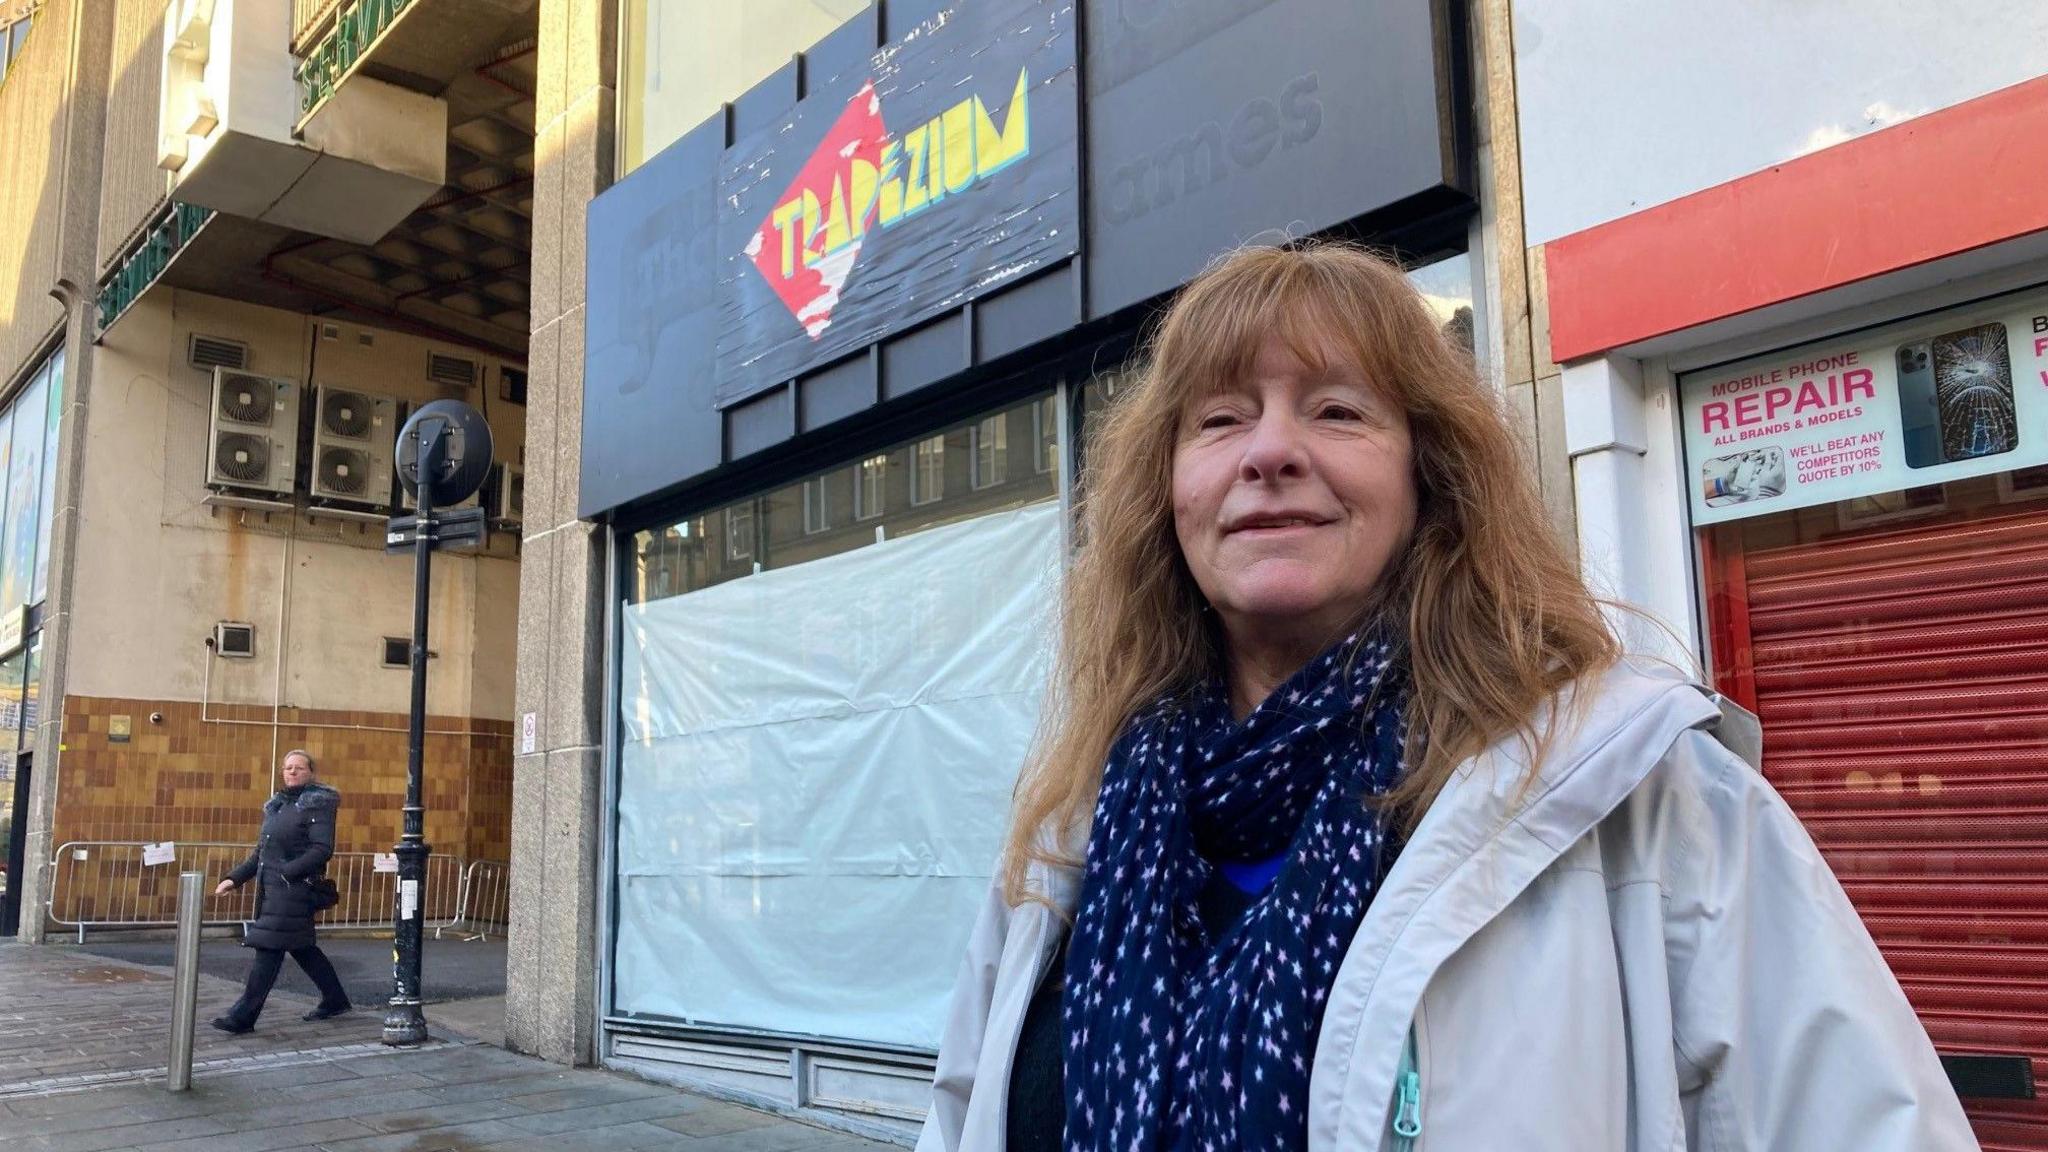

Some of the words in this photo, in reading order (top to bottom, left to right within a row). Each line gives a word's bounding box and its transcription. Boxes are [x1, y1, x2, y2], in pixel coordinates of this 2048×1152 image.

[773, 65, 1029, 279] TRAPEZIUM
[1712, 370, 1783, 397] MOBILE
[1789, 352, 1859, 379] PHONE
[1702, 368, 1875, 434] REPAIR
[1714, 434, 1736, 447] ALL
[1740, 422, 1790, 441] BRANDS
[1795, 419, 1803, 429] &
[1808, 407, 1863, 426] MODELS
[1790, 443, 1825, 458] WE'LL
[1828, 435, 1858, 451] BEAT
[1861, 430, 1885, 445] ANY
[1797, 446, 1881, 471] COMPETITORS
[1798, 466, 1837, 484] QUOTE
[1840, 463, 1855, 477] BY
[1859, 460, 1882, 473] 10%
